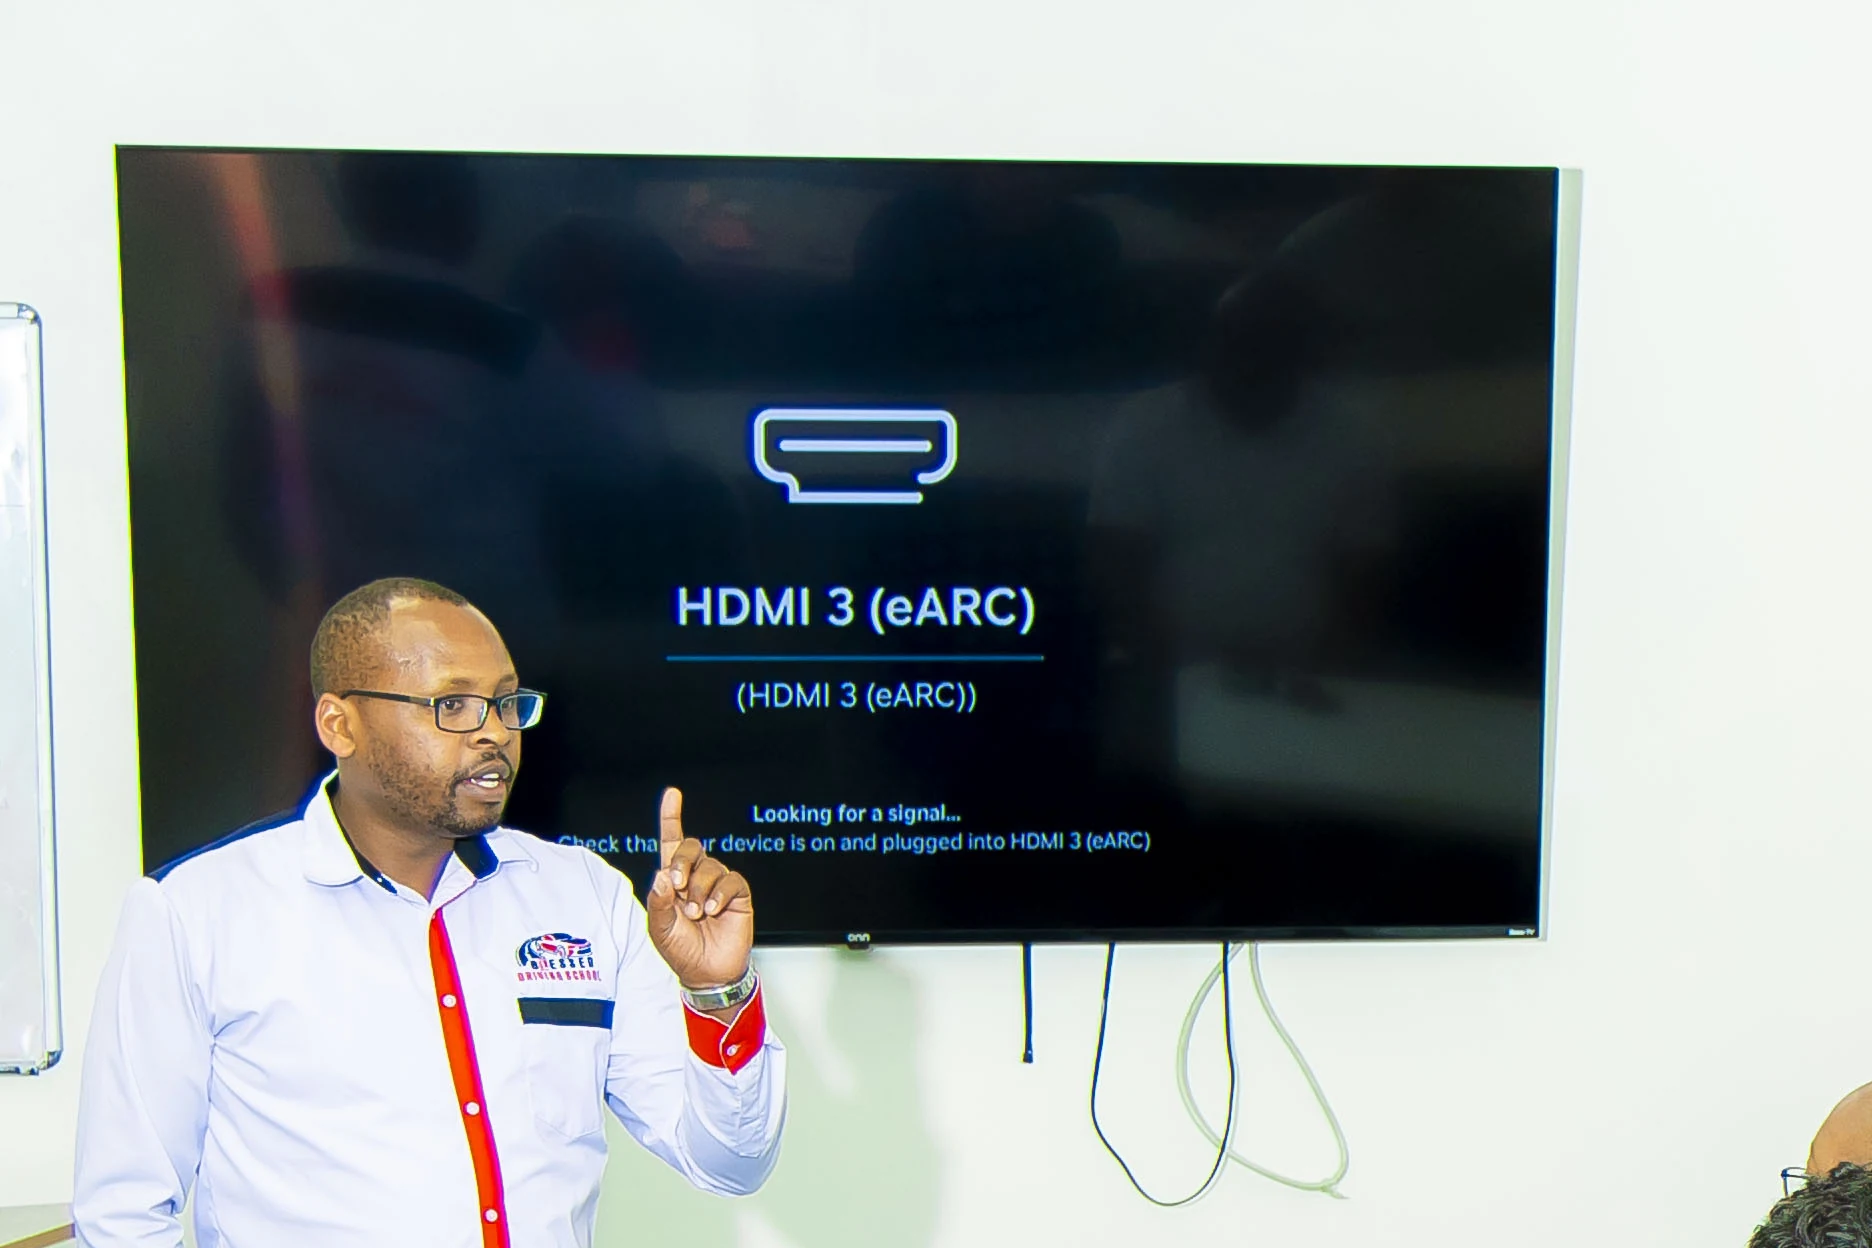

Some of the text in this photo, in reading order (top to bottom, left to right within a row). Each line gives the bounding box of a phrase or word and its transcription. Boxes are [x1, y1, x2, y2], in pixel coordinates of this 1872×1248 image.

[676, 586, 1035, 634] HDMI 3 (eARC)
[737, 682, 977, 714] (HDMI 3 (eARC))
[753, 804, 961, 827] Looking for a signal...
[626, 834, 658, 853] tha
[720, 834, 786, 852] device
[791, 834, 806, 851] is
[810, 838, 836, 852] on
[840, 833, 877, 851] and
[882, 832, 963, 855] plugged
[968, 832, 1006, 850] into
[1011, 832, 1064, 850] HDMI
[1070, 831, 1082, 850] 3
[1086, 831, 1151, 853] (eARC)
[517, 969, 602, 982] DRIVING SCHOOL
